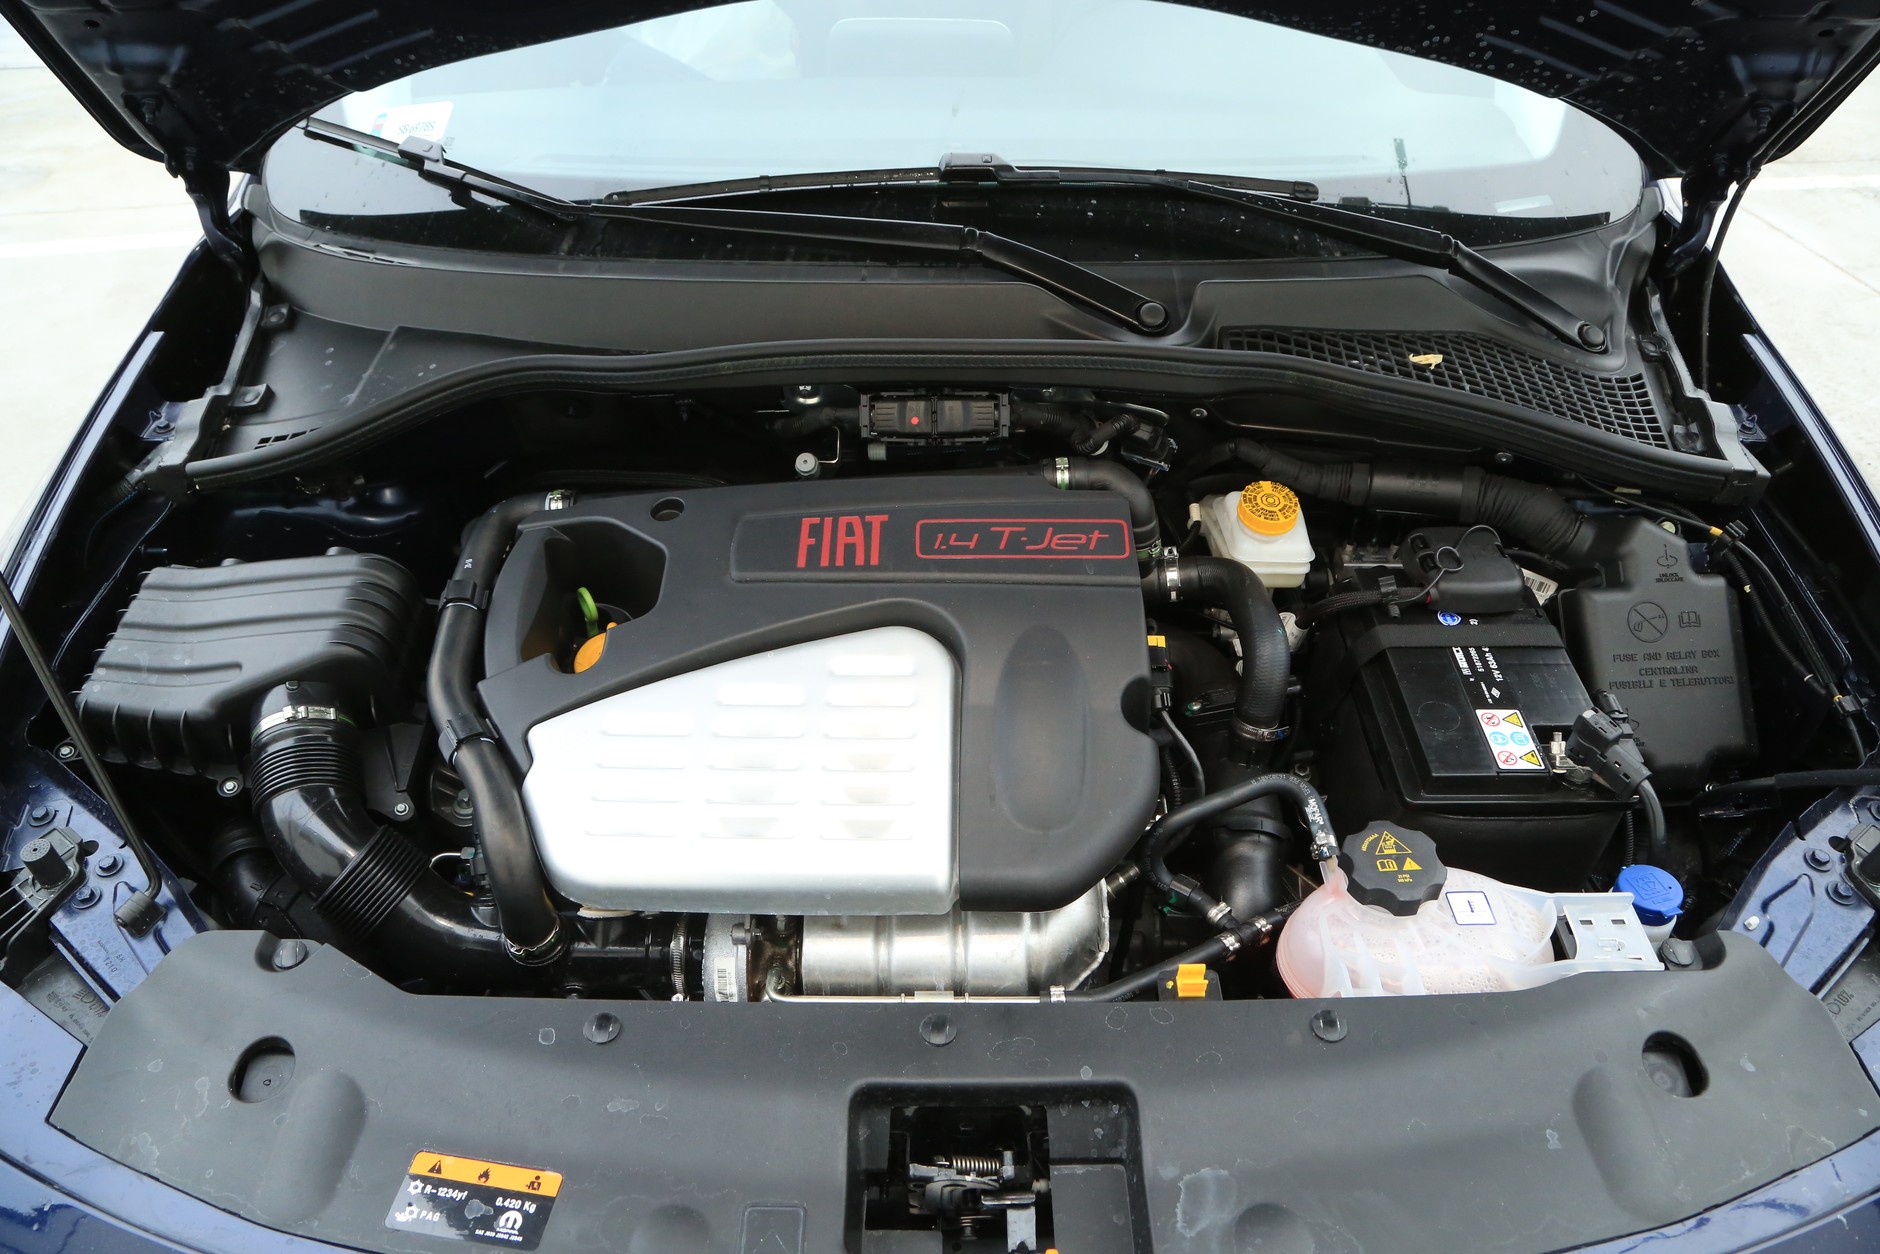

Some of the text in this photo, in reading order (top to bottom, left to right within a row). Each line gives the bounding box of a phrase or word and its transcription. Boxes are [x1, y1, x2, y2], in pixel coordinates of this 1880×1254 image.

[797, 514, 889, 568] FIAT
[933, 533, 979, 550] 1.4
[1485, 652, 1498, 670] 63Ah
[1612, 649, 1721, 663] FUSE AND RELAY BOX
[1492, 669, 1504, 682] 12V
[1638, 665, 1699, 677] CENTRALINA
[1609, 675, 1736, 690] FUSIBILI E TELERUTTORI
[424, 1184, 537, 1214] R-1234yf 0.420 Kg
[419, 1210, 441, 1222] PAG
